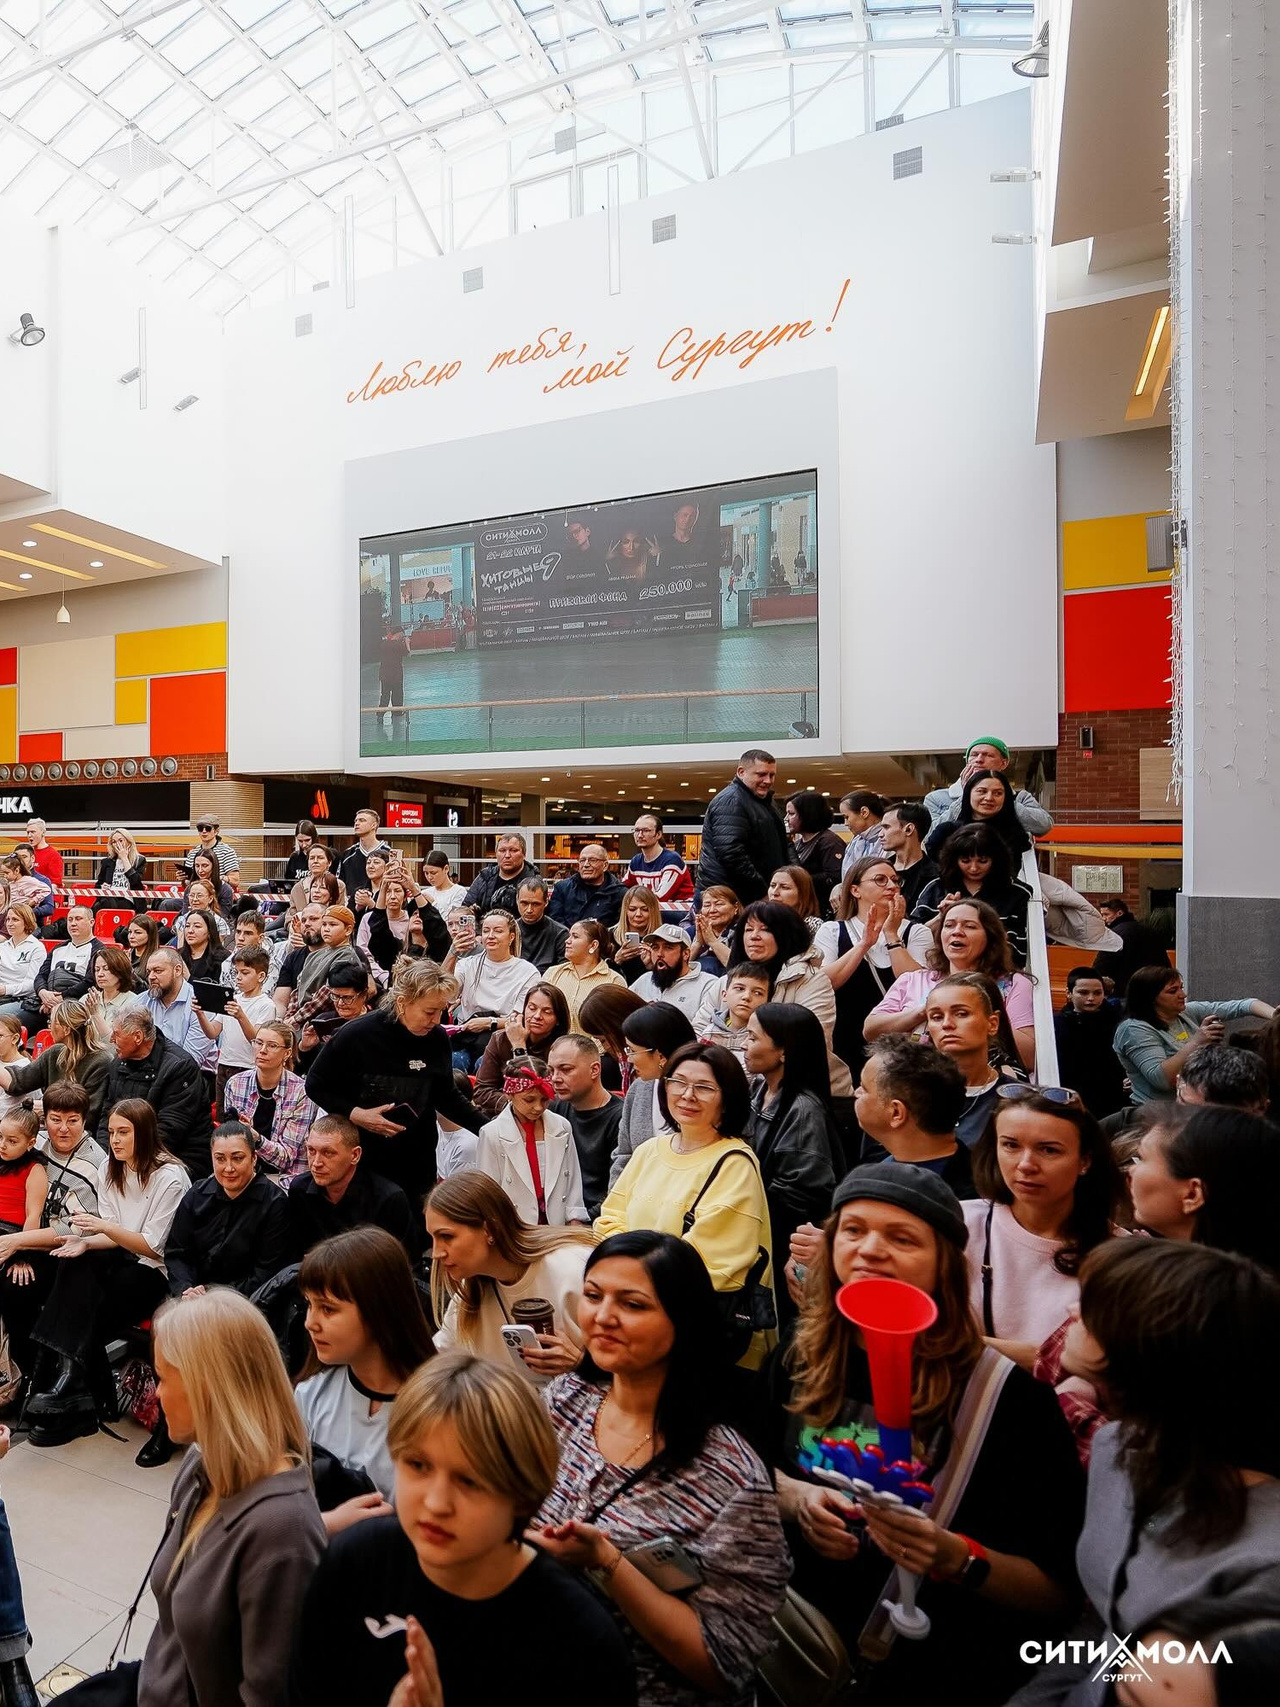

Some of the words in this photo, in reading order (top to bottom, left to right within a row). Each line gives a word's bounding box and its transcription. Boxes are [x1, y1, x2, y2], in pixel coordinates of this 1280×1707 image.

[346, 358, 463, 404] Люблю
[488, 326, 588, 373] тебя,
[543, 350, 635, 395] мой
[480, 562, 542, 588] ХИТОВЫЕ
[494, 574, 533, 594] ТАНЦЫ
[638, 578, 693, 600] 250.000
